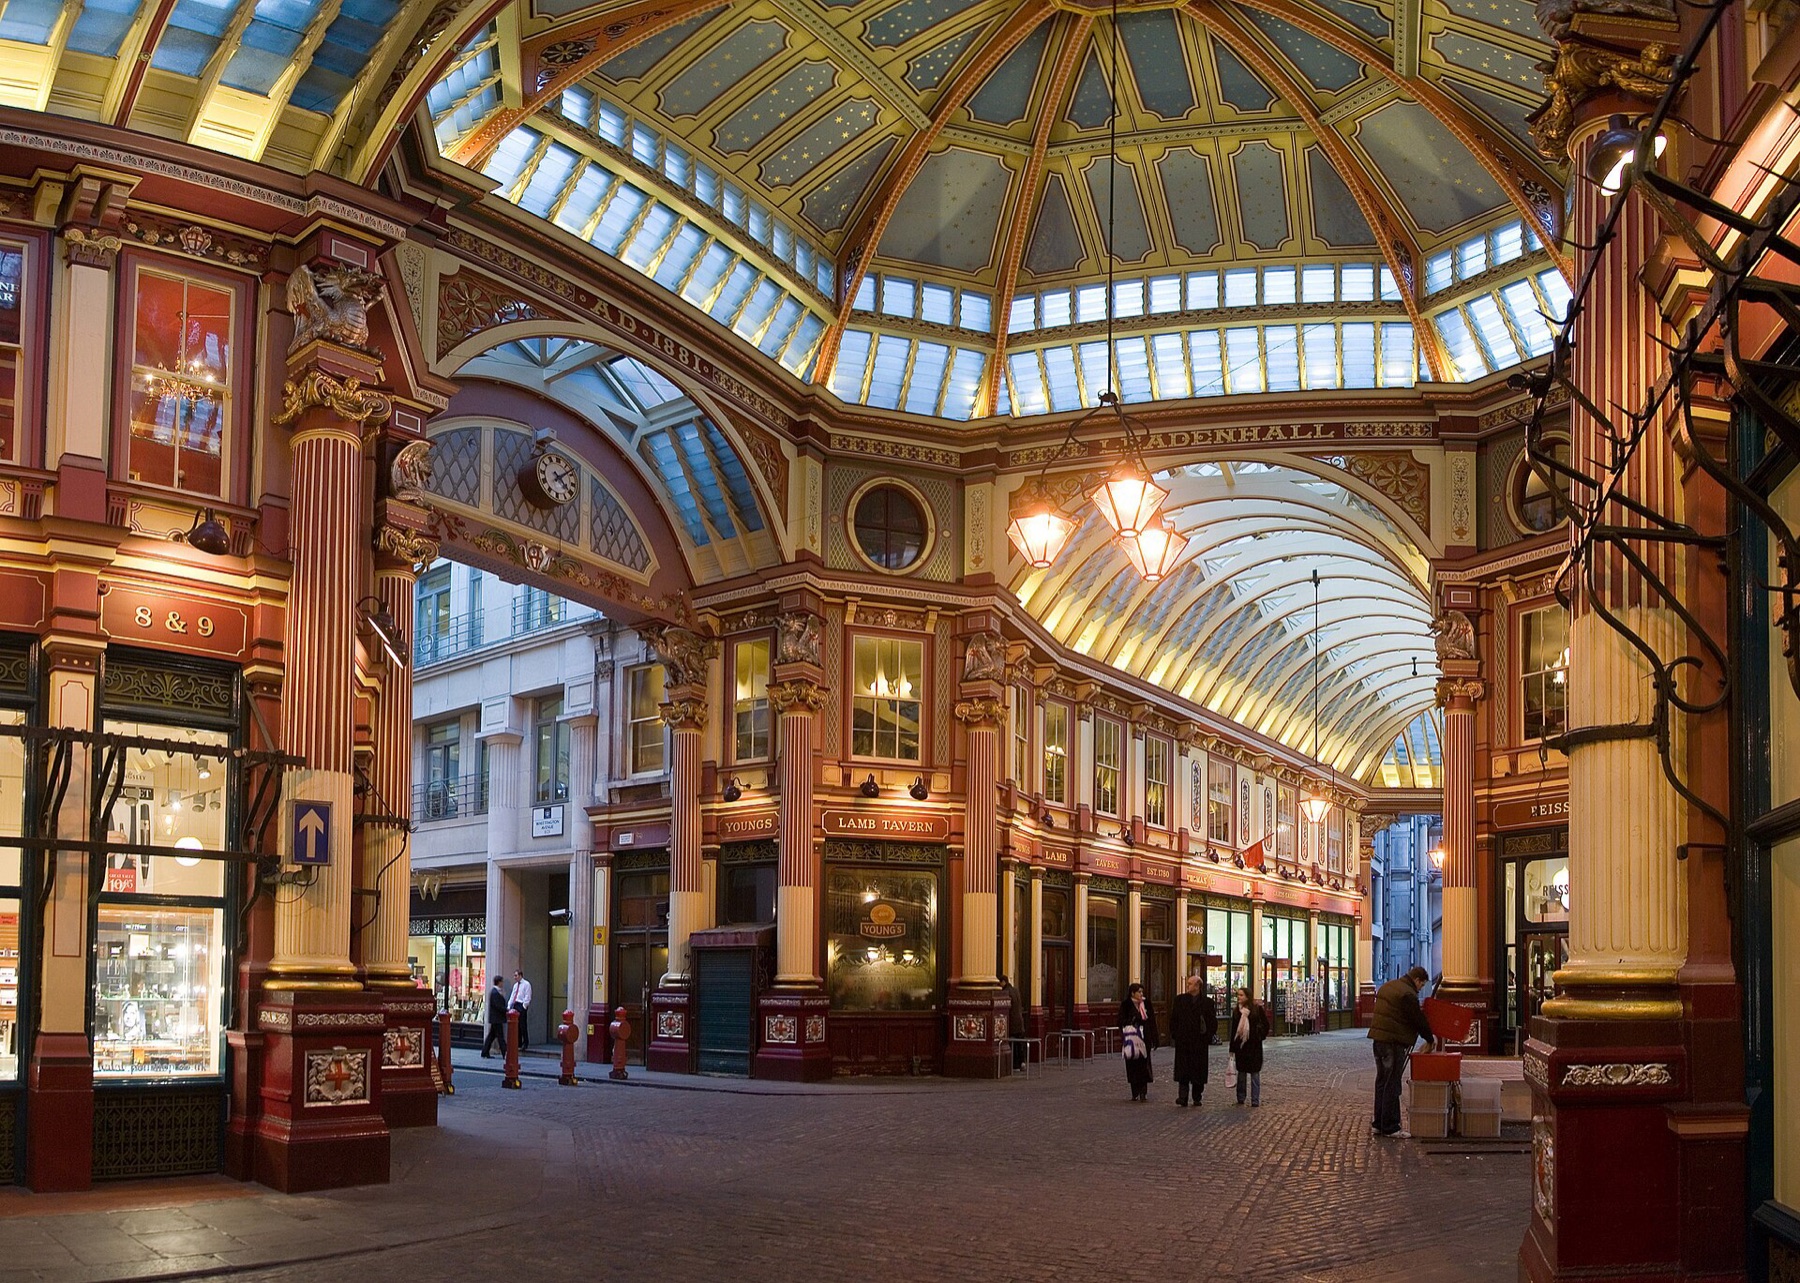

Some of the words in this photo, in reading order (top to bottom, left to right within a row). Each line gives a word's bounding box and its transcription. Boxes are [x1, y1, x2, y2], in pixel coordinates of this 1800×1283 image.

[590, 298, 637, 333] AD
[652, 330, 701, 374] 1881
[1099, 423, 1335, 454] LEADENHALL
[135, 606, 152, 627] 8
[165, 611, 187, 633] &
[197, 616, 214, 637] 9
[725, 818, 773, 832] YOUNGS
[838, 817, 876, 829] LAMB
[881, 820, 933, 832] TAVERN
[1045, 851, 1067, 862] LAMB
[1095, 858, 1120, 869] TAVERN
[864, 925, 902, 935] YOUNG'S
